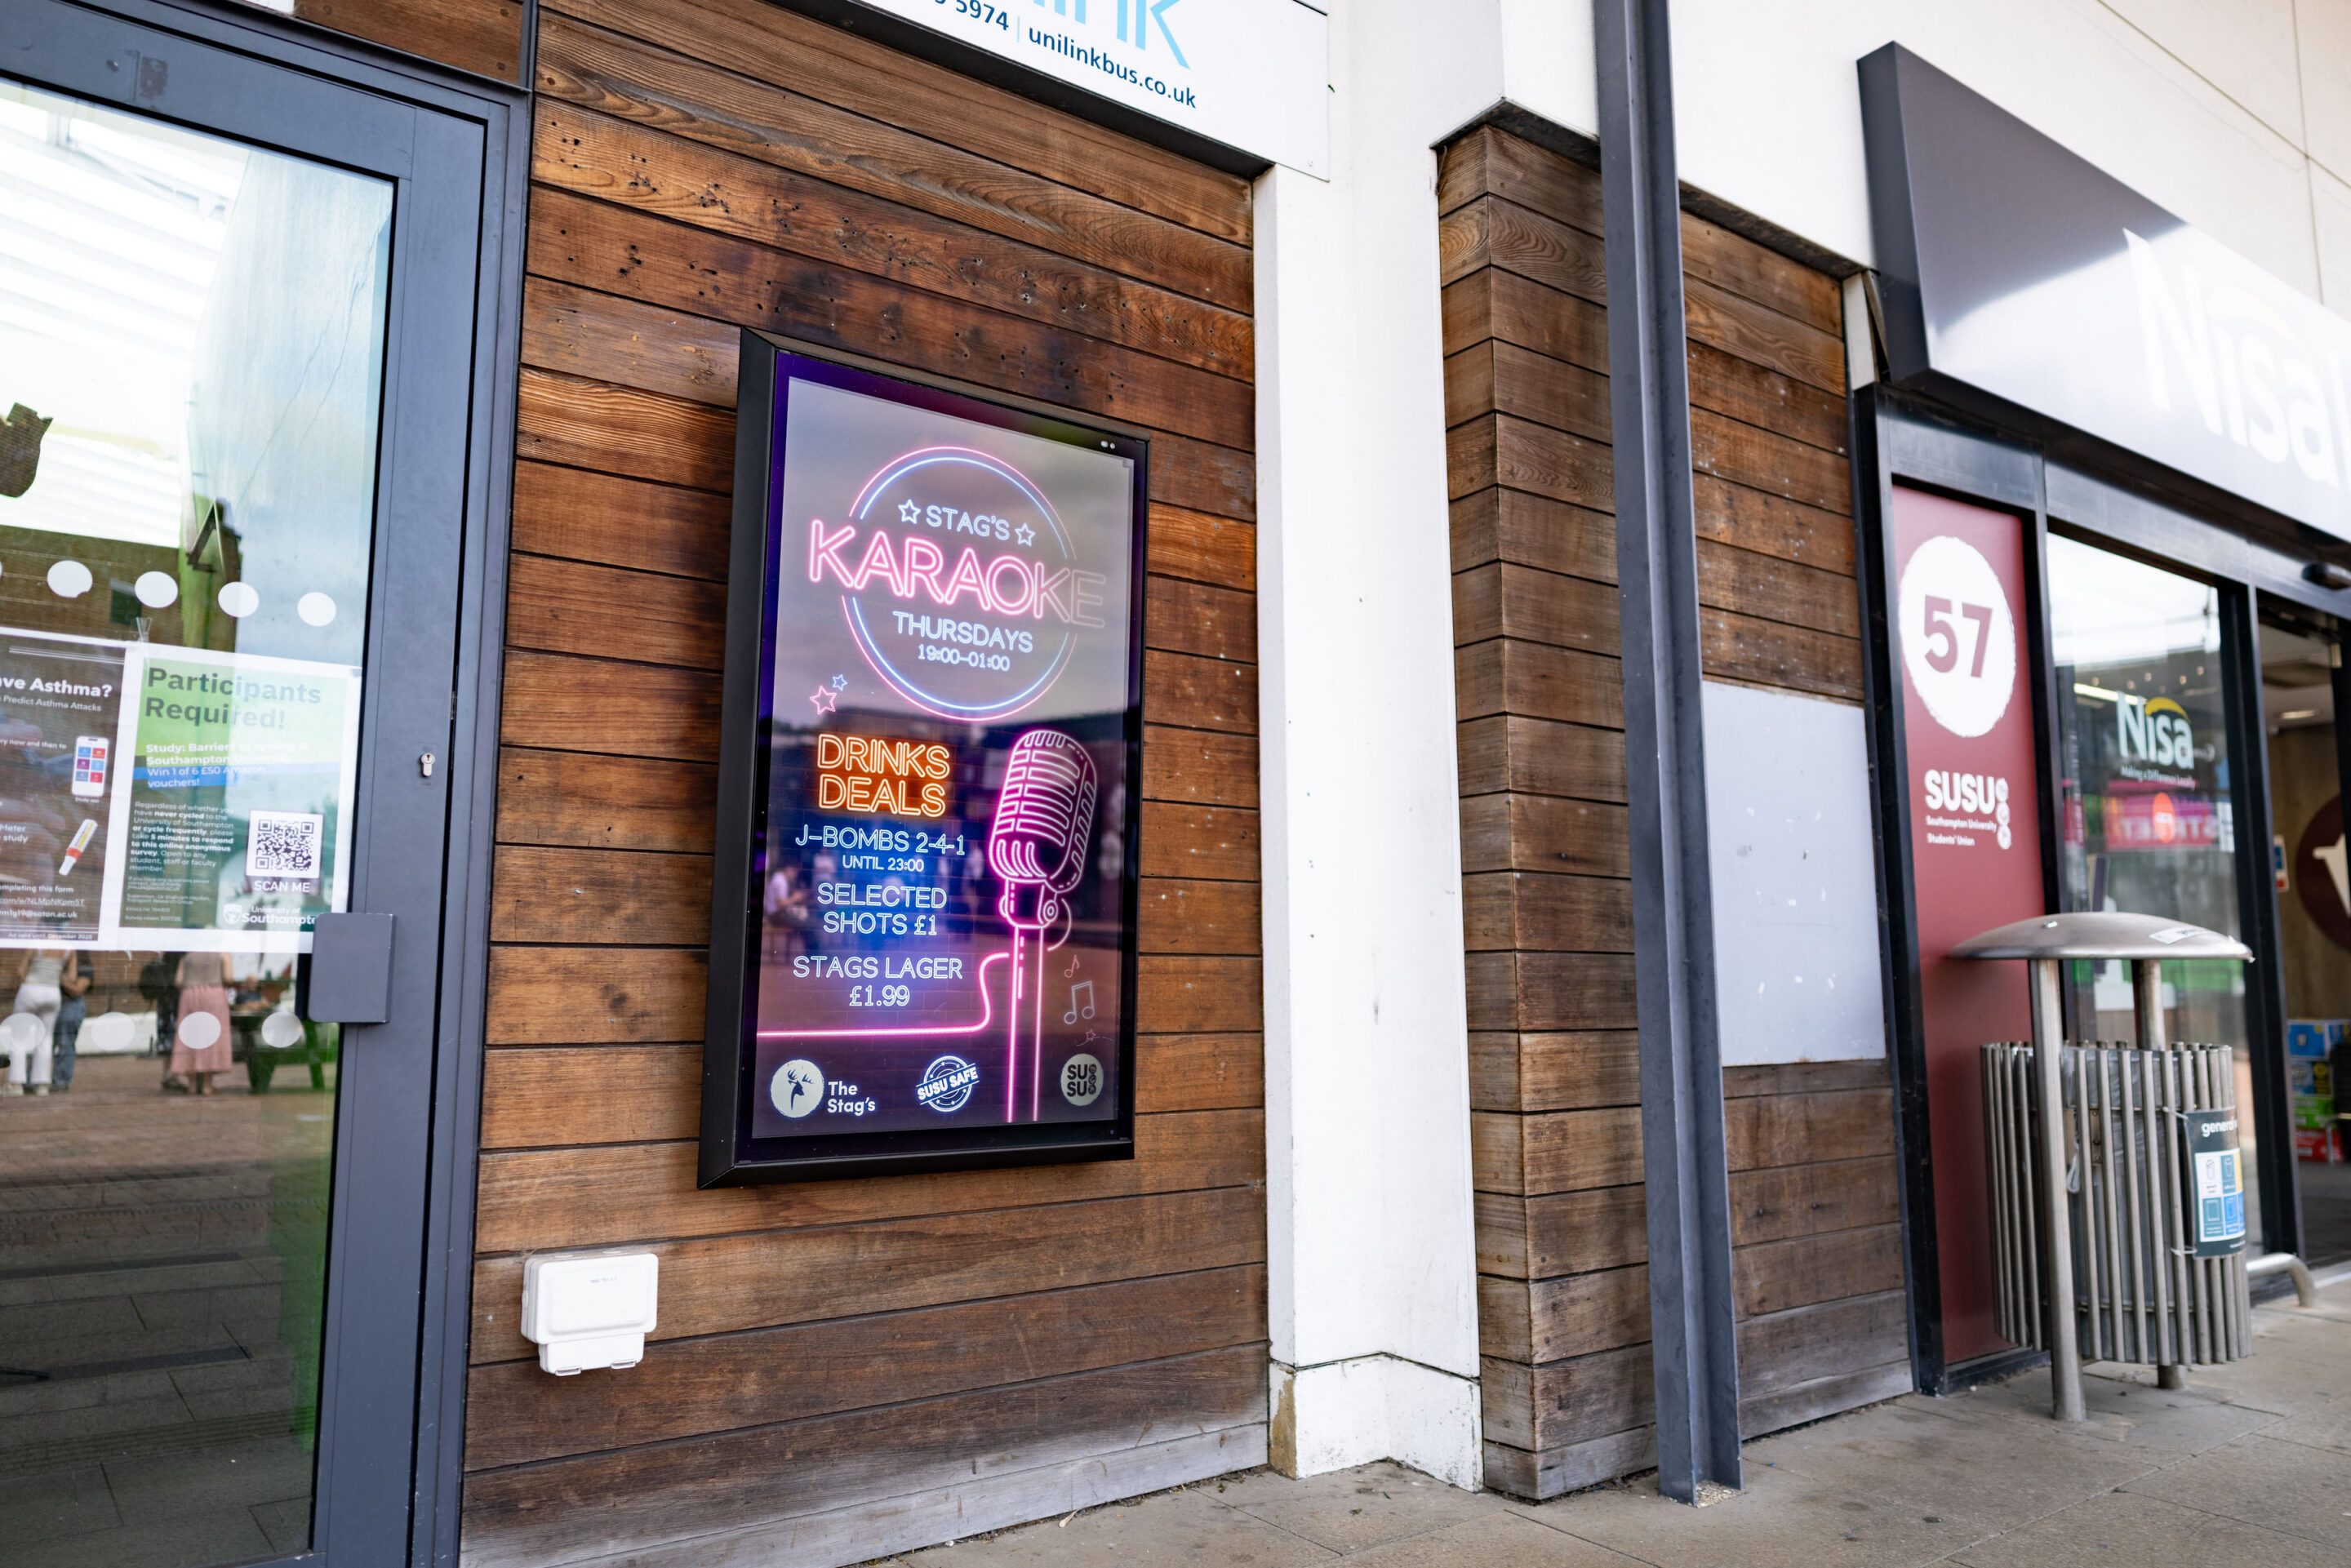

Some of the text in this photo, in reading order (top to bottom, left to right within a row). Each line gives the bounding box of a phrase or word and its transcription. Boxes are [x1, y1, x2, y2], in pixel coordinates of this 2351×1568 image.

[956, 0, 1009, 31] 5974
[1029, 27, 1196, 109] unilinkbus.co.uk
[2122, 227, 2340, 489] Nisa
[926, 505, 1011, 541] STAG'S
[808, 519, 1108, 629] KARAOKE
[892, 611, 1033, 654] THURSDAYS
[1923, 594, 1993, 679] 57
[29, 677, 113, 698] Asthma?
[147, 666, 321, 704] Participants
[3, 694, 102, 713] Predict Asthma Attacks
[144, 696, 285, 730] Required!
[2116, 691, 2194, 770] Nisa
[145, 743, 185, 754] Study:
[816, 733, 951, 780] DRINKS
[145, 754, 229, 767] Southampton
[147, 765, 266, 777] Win 1 of 6 £50 Amazon
[147, 777, 200, 788] vouchers!
[1924, 768, 1996, 815] SUSU
[818, 774, 946, 817] DEALS
[135, 801, 177, 811] Regardless
[178, 811, 204, 820] cycled
[133, 817, 171, 826] University
[182, 820, 233, 829] Southampton
[143, 825, 164, 834] cycle
[209, 829, 233, 837] please
[141, 841, 158, 849] this
[158, 842, 184, 850] online
[184, 844, 231, 853] anonymous
[157, 834, 190, 842] minutes
[202, 837, 234, 845] respond
[795, 824, 966, 856] J-BOMBS 2-4-1
[160, 850, 183, 859] Open
[842, 855, 925, 873] UNTIL 23:00
[253, 880, 310, 893] SCAN ME
[817, 882, 947, 909] SELECTED
[242, 913, 315, 927] Southampt
[823, 912, 938, 936] SHOTS £1
[793, 955, 963, 980] STAGS LAGER
[849, 984, 910, 1007] £1.99
[1067, 1064, 1088, 1080] SU
[828, 1081, 858, 1096] The
[918, 1066, 979, 1101] SUSU SAFE
[1066, 1081, 1087, 1097] SU
[828, 1097, 876, 1117] Stag's
